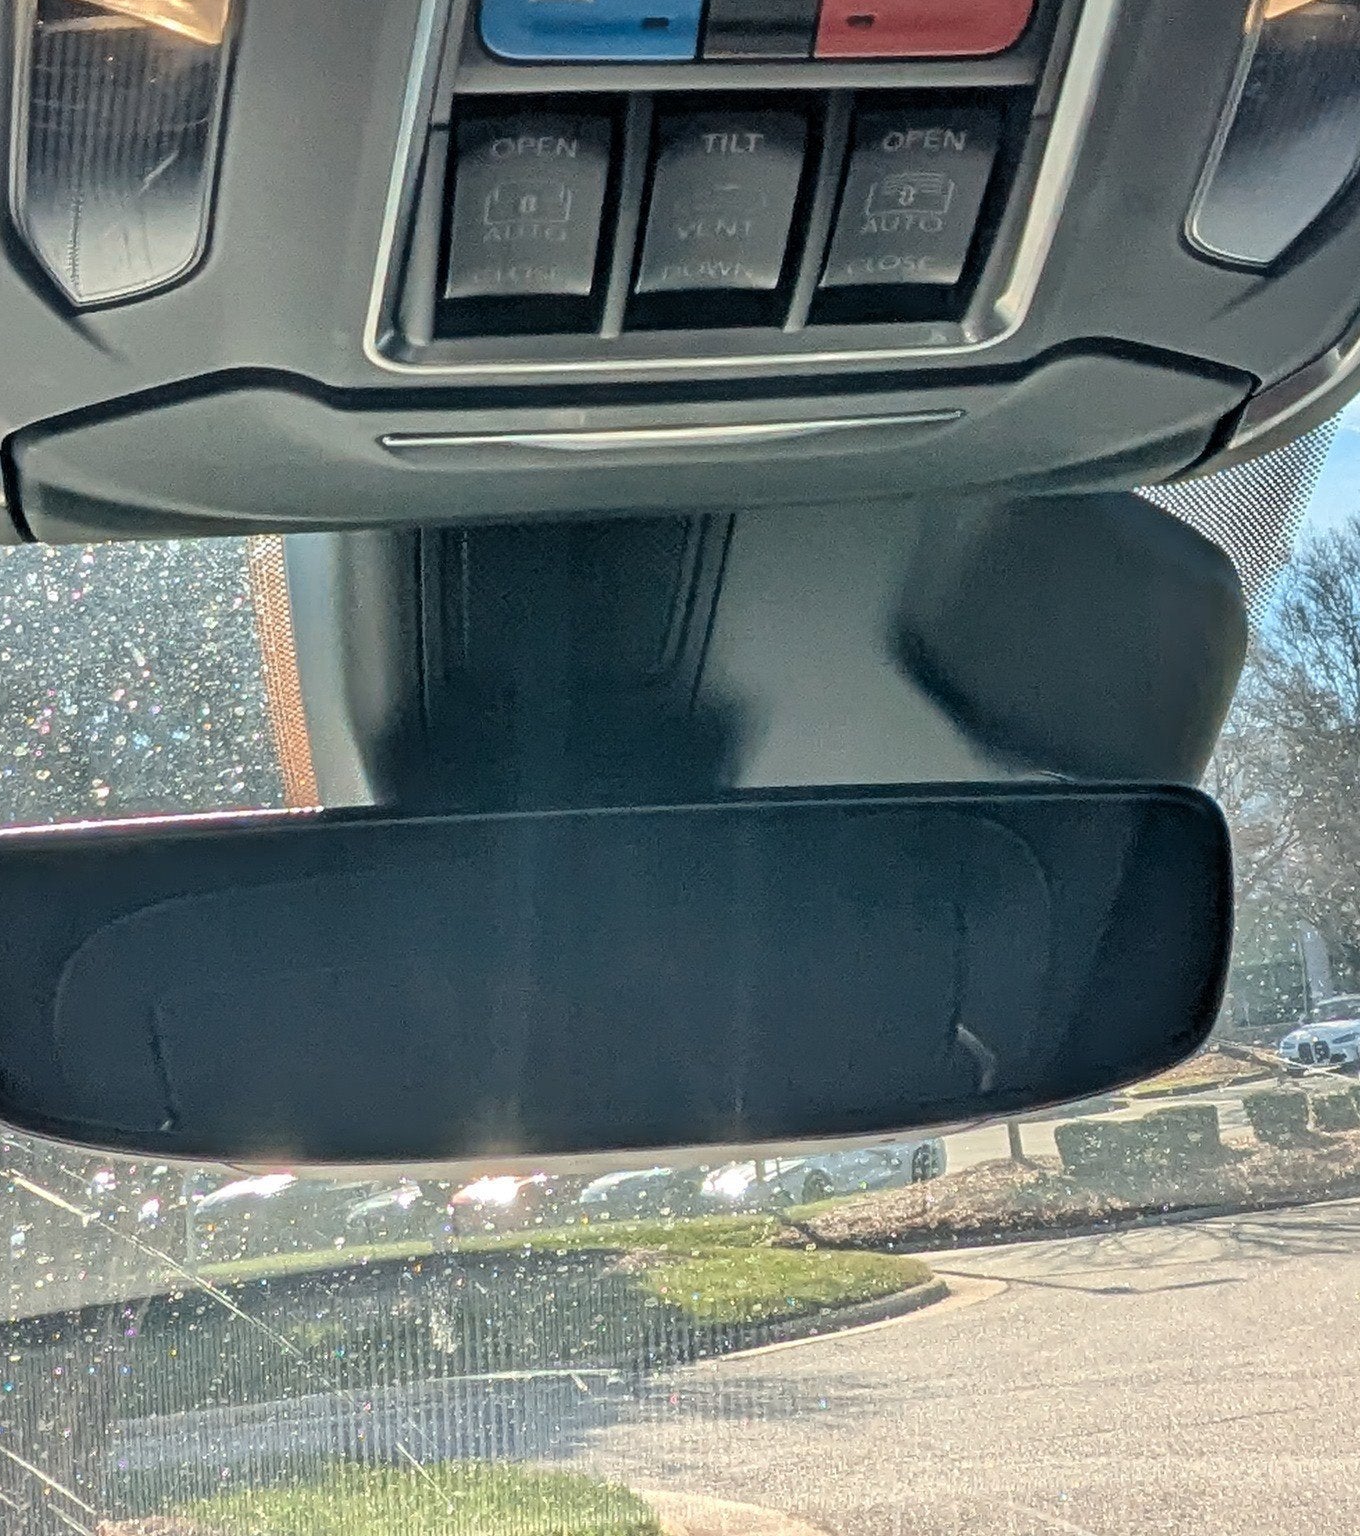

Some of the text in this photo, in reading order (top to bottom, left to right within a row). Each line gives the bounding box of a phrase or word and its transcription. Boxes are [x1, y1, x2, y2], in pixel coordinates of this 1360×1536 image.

[490, 136, 578, 159] OPEN
[701, 132, 764, 154] TILT
[880, 127, 968, 152] OPEN
[859, 212, 943, 235] AUTO
